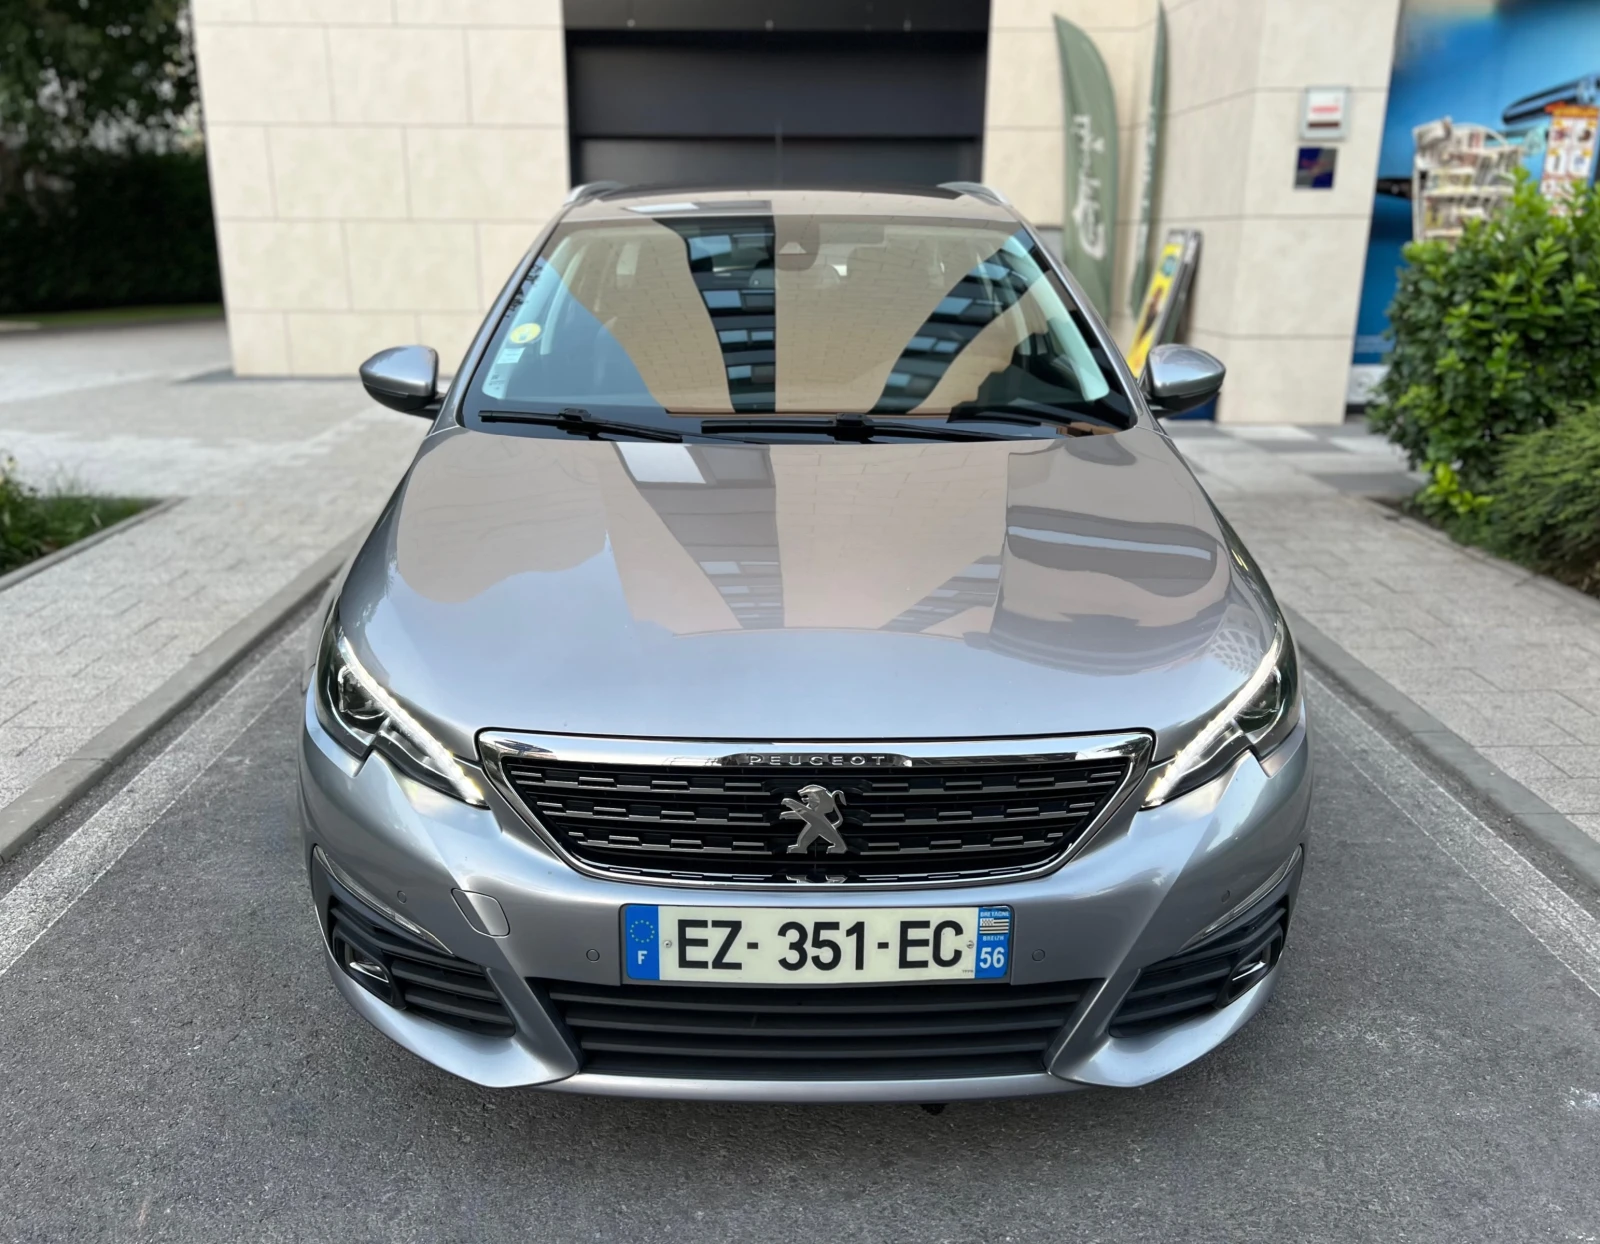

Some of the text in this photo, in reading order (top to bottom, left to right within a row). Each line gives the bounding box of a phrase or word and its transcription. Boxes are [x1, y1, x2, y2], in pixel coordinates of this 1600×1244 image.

[749, 755, 886, 766] PEUGEOT
[637, 950, 647, 965] F
[979, 946, 1005, 969] 56
